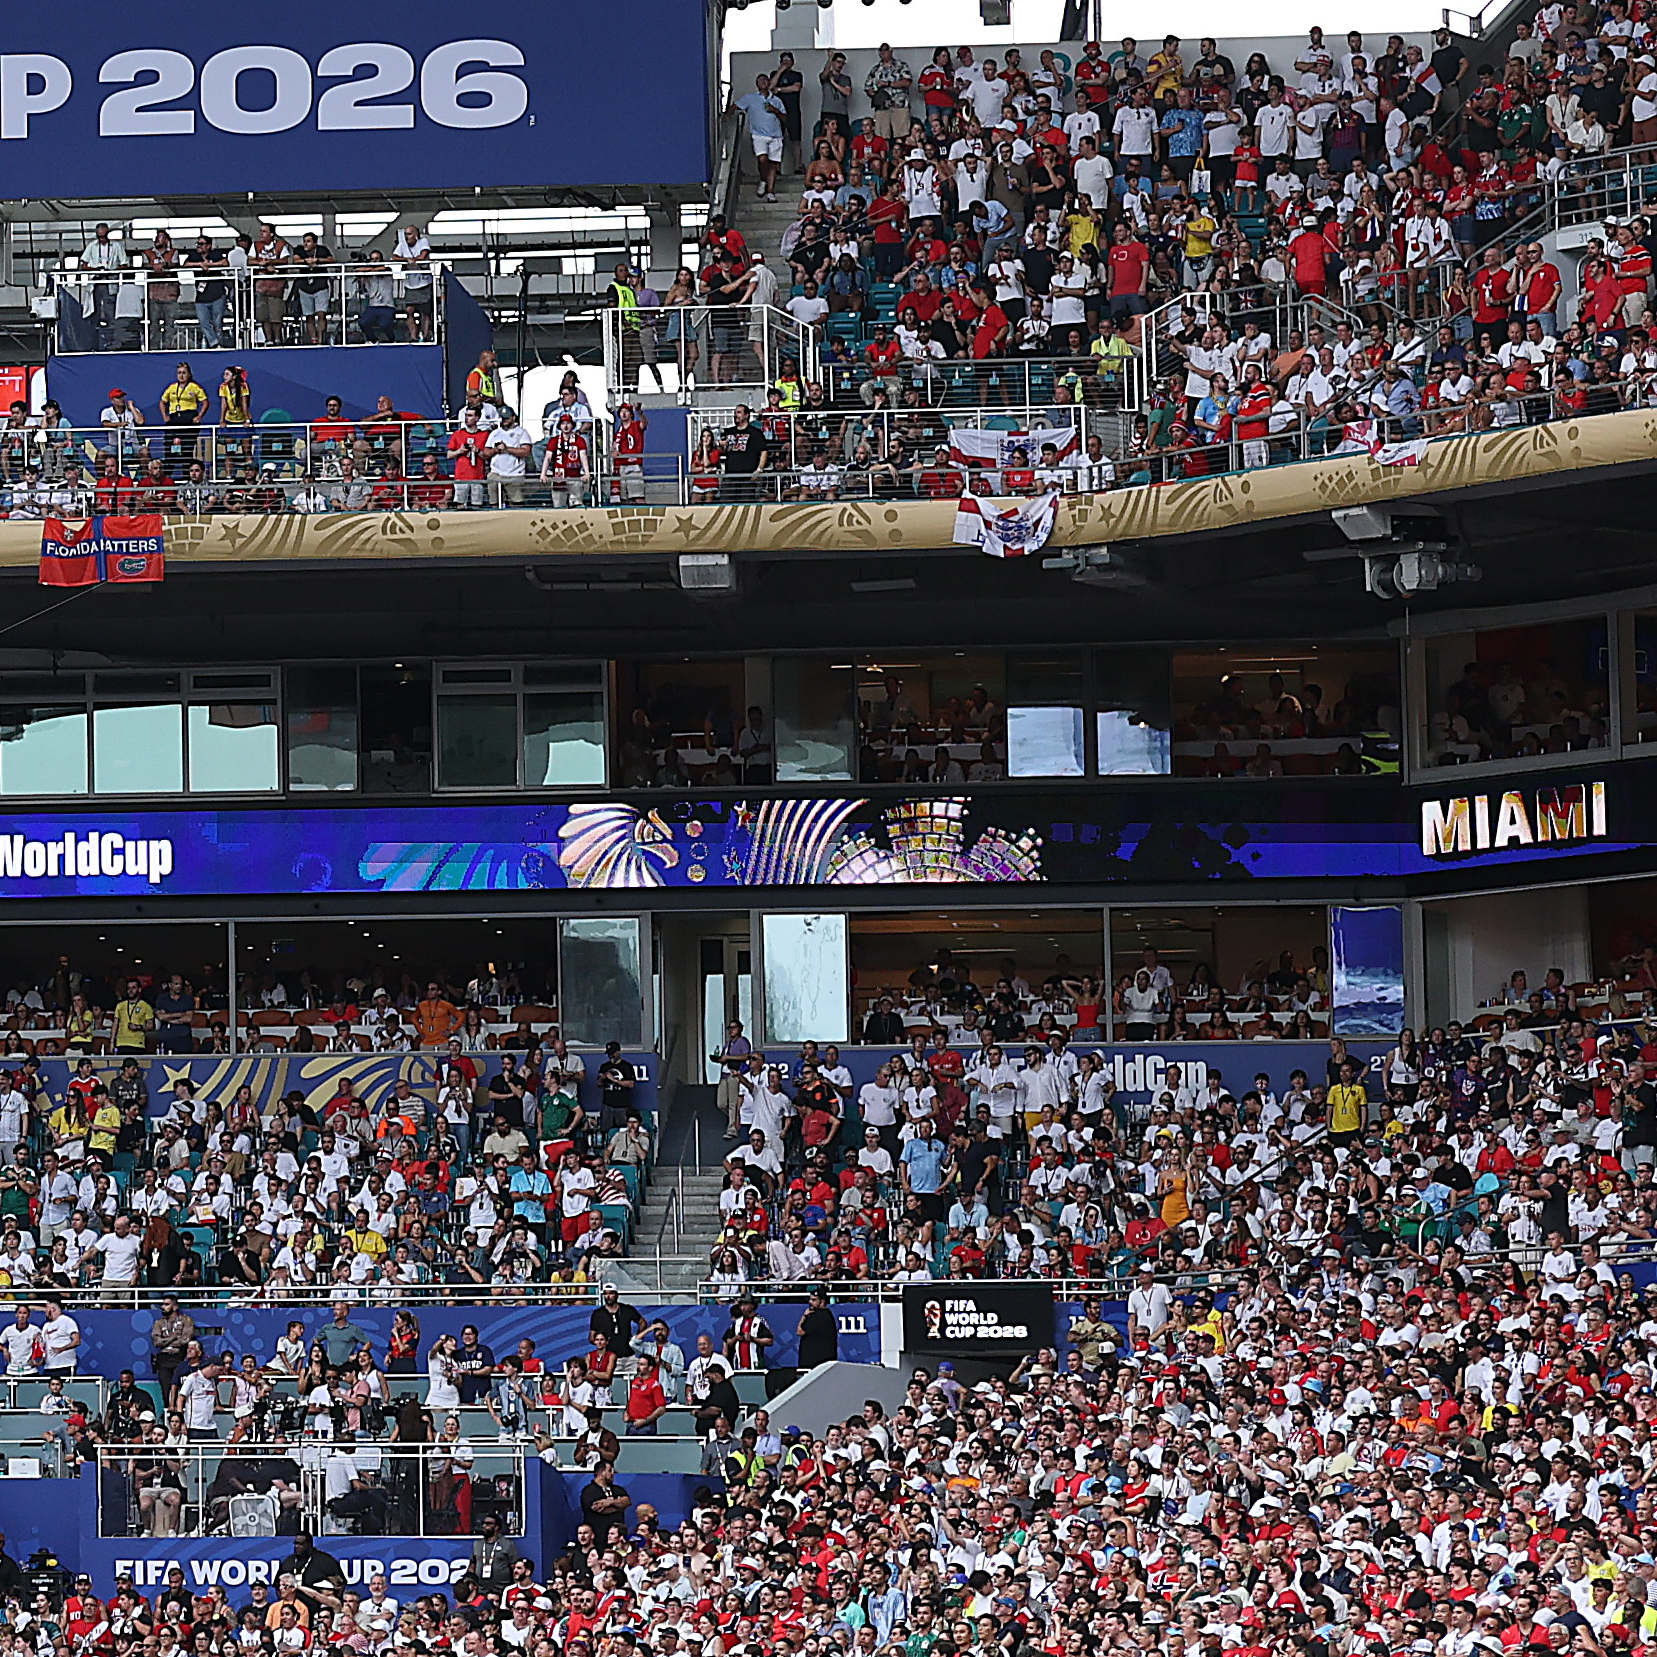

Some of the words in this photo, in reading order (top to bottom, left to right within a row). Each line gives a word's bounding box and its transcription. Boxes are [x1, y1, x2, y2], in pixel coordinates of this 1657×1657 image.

[98, 39, 529, 138] 2026
[1421, 781, 1608, 857] MIAMI
[945, 1299, 977, 1312] FIFA
[838, 1316, 868, 1334] 111
[944, 1312, 999, 1326] WORLD
[945, 1325, 975, 1339] CUP
[976, 1325, 1028, 1338] 2026
[115, 1559, 181, 1586] FIFA
[339, 1559, 385, 1585] UP
[390, 1558, 472, 1585] 202
